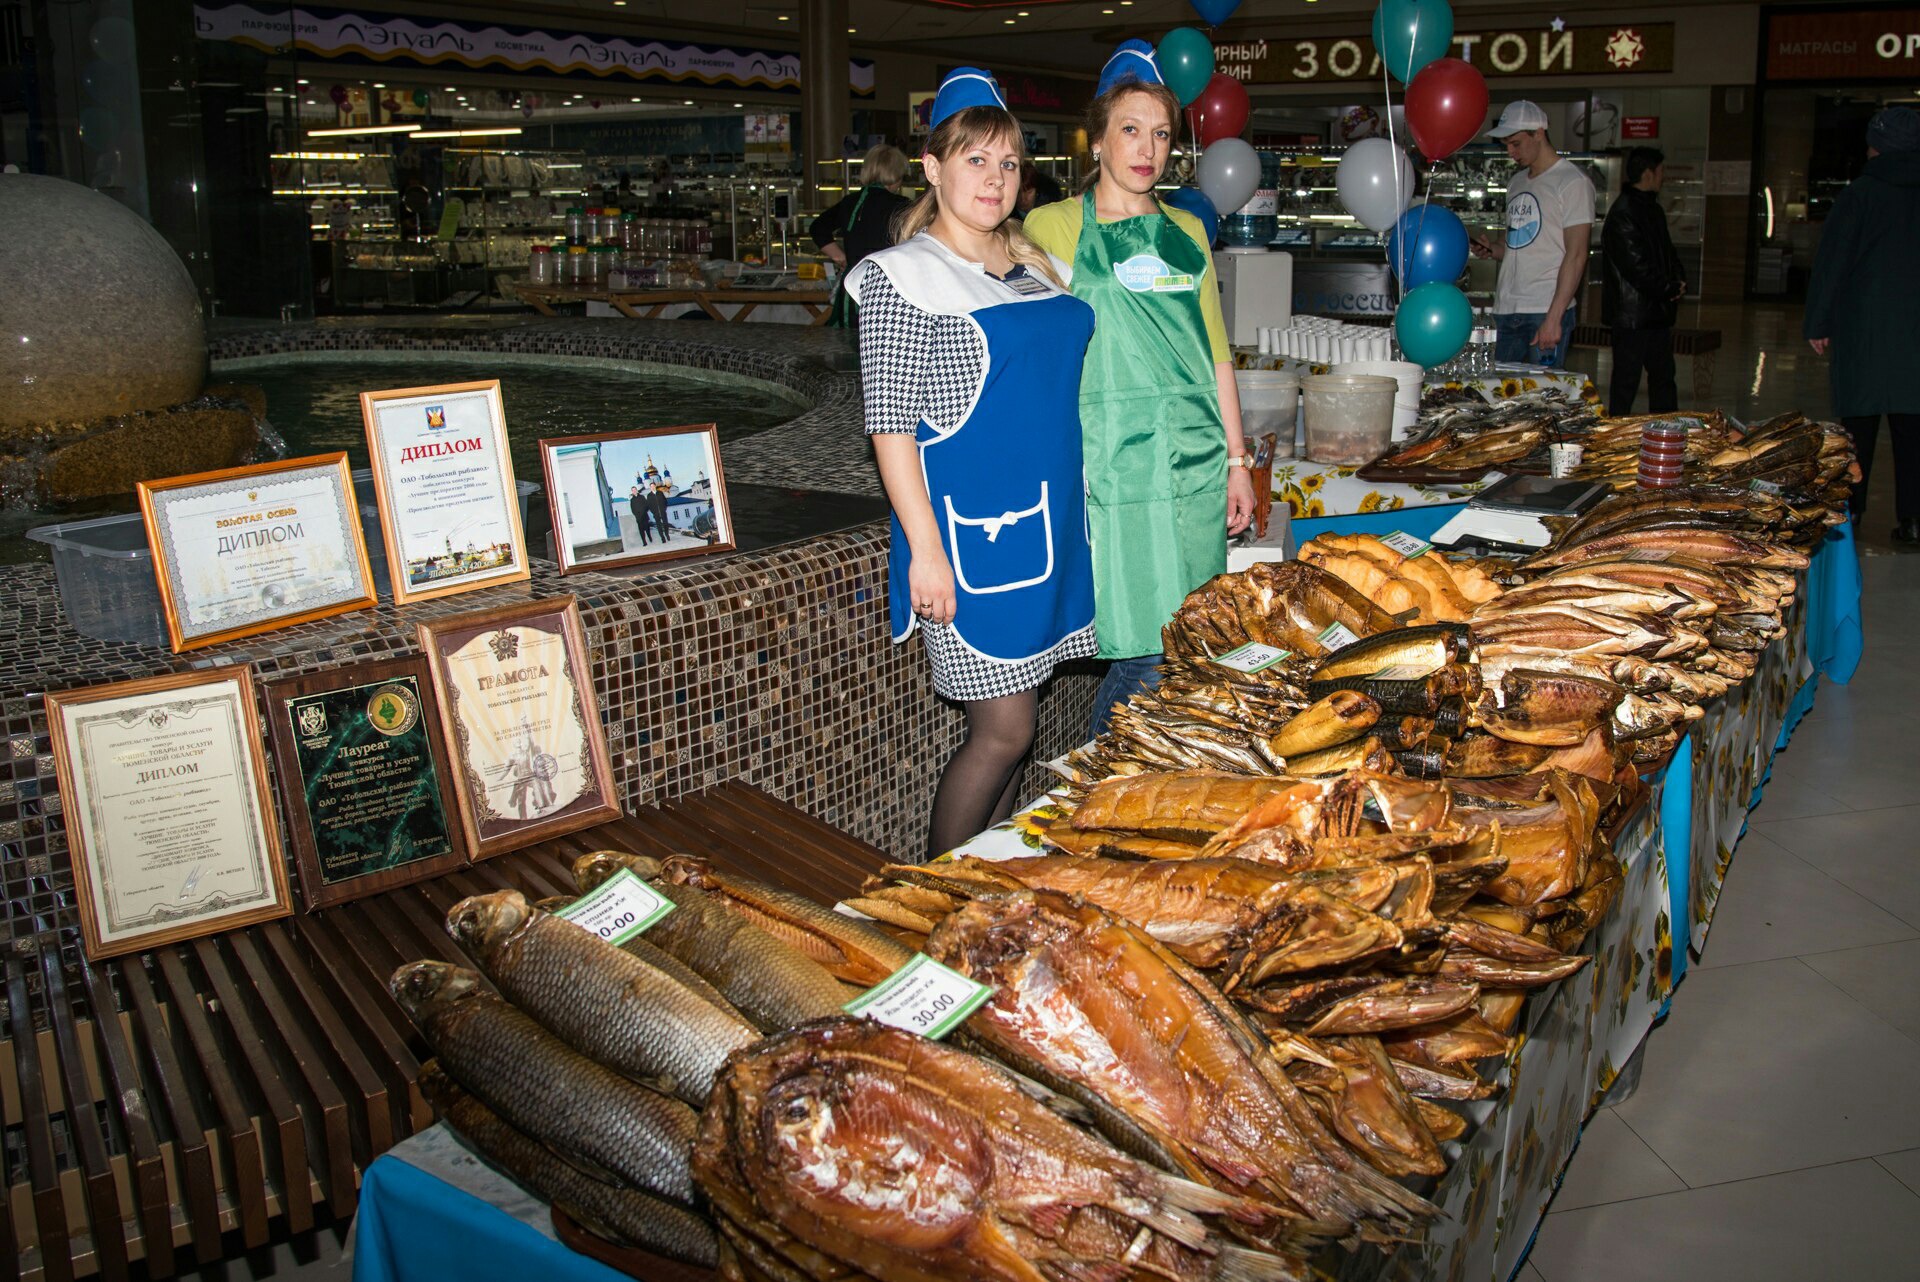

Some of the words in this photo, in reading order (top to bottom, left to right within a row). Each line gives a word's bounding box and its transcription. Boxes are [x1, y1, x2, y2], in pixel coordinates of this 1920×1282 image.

[241, 19, 320, 34] ПАРФЮМЕРИЯ
[1213, 39, 1268, 62] ИРНЫЙ
[1292, 20, 1574, 79] ЗОТОЙ
[1778, 40, 1857, 56] МАТРАСЫ
[400, 437, 482, 464] ДИПЛОМ
[399, 475, 417, 484] ОАО
[215, 513, 262, 528] ЗОЛОТАЯ
[266, 507, 297, 519] ОСЕНЬ
[217, 522, 304, 556] ДИПЛОМ
[468, 560, 482, 570] 420
[477, 664, 549, 691] ГРАМОТА
[149, 746, 178, 756] ТОВАРЫ
[185, 739, 213, 750] УСЛУГИ
[337, 740, 390, 759] Лауреат
[122, 753, 169, 768] ТЮМЕНСКОЙ
[348, 754, 385, 767] конкурса
[355, 763, 385, 775] товары
[393, 755, 420, 767] услуги
[135, 762, 199, 784] ДИПЛОМ
[327, 772, 375, 789] Тюменской
[318, 796, 337, 808] ОАО
[584, 905, 614, 925] спинка
[592, 911, 635, 939] 0-00
[911, 993, 954, 1027] 30-00
